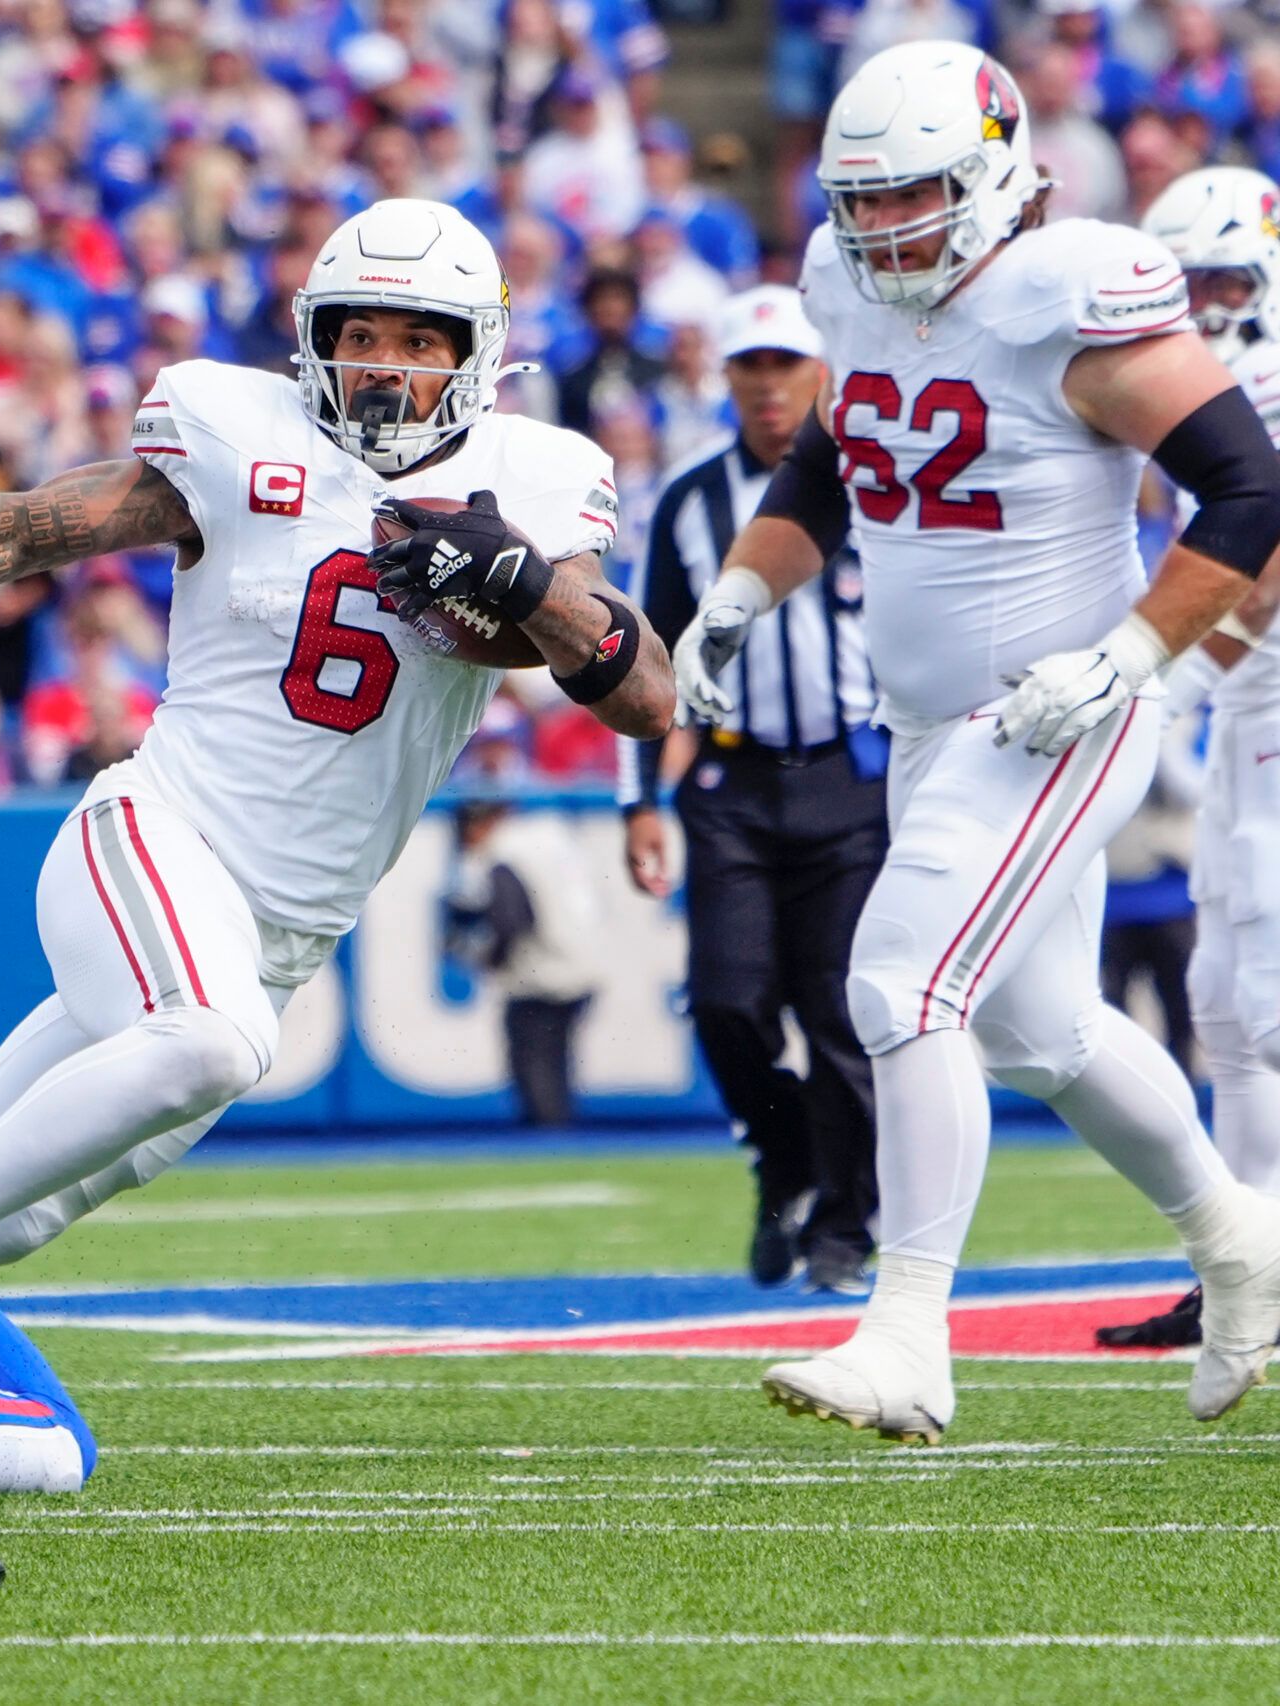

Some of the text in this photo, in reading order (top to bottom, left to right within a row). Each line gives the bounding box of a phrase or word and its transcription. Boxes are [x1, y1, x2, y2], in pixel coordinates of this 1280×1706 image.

[358, 275, 412, 285] CARDINALS
[833, 371, 1004, 530] 62
[254, 464, 302, 503] C
[429, 552, 473, 590] adidas
[279, 547, 400, 736] 6
